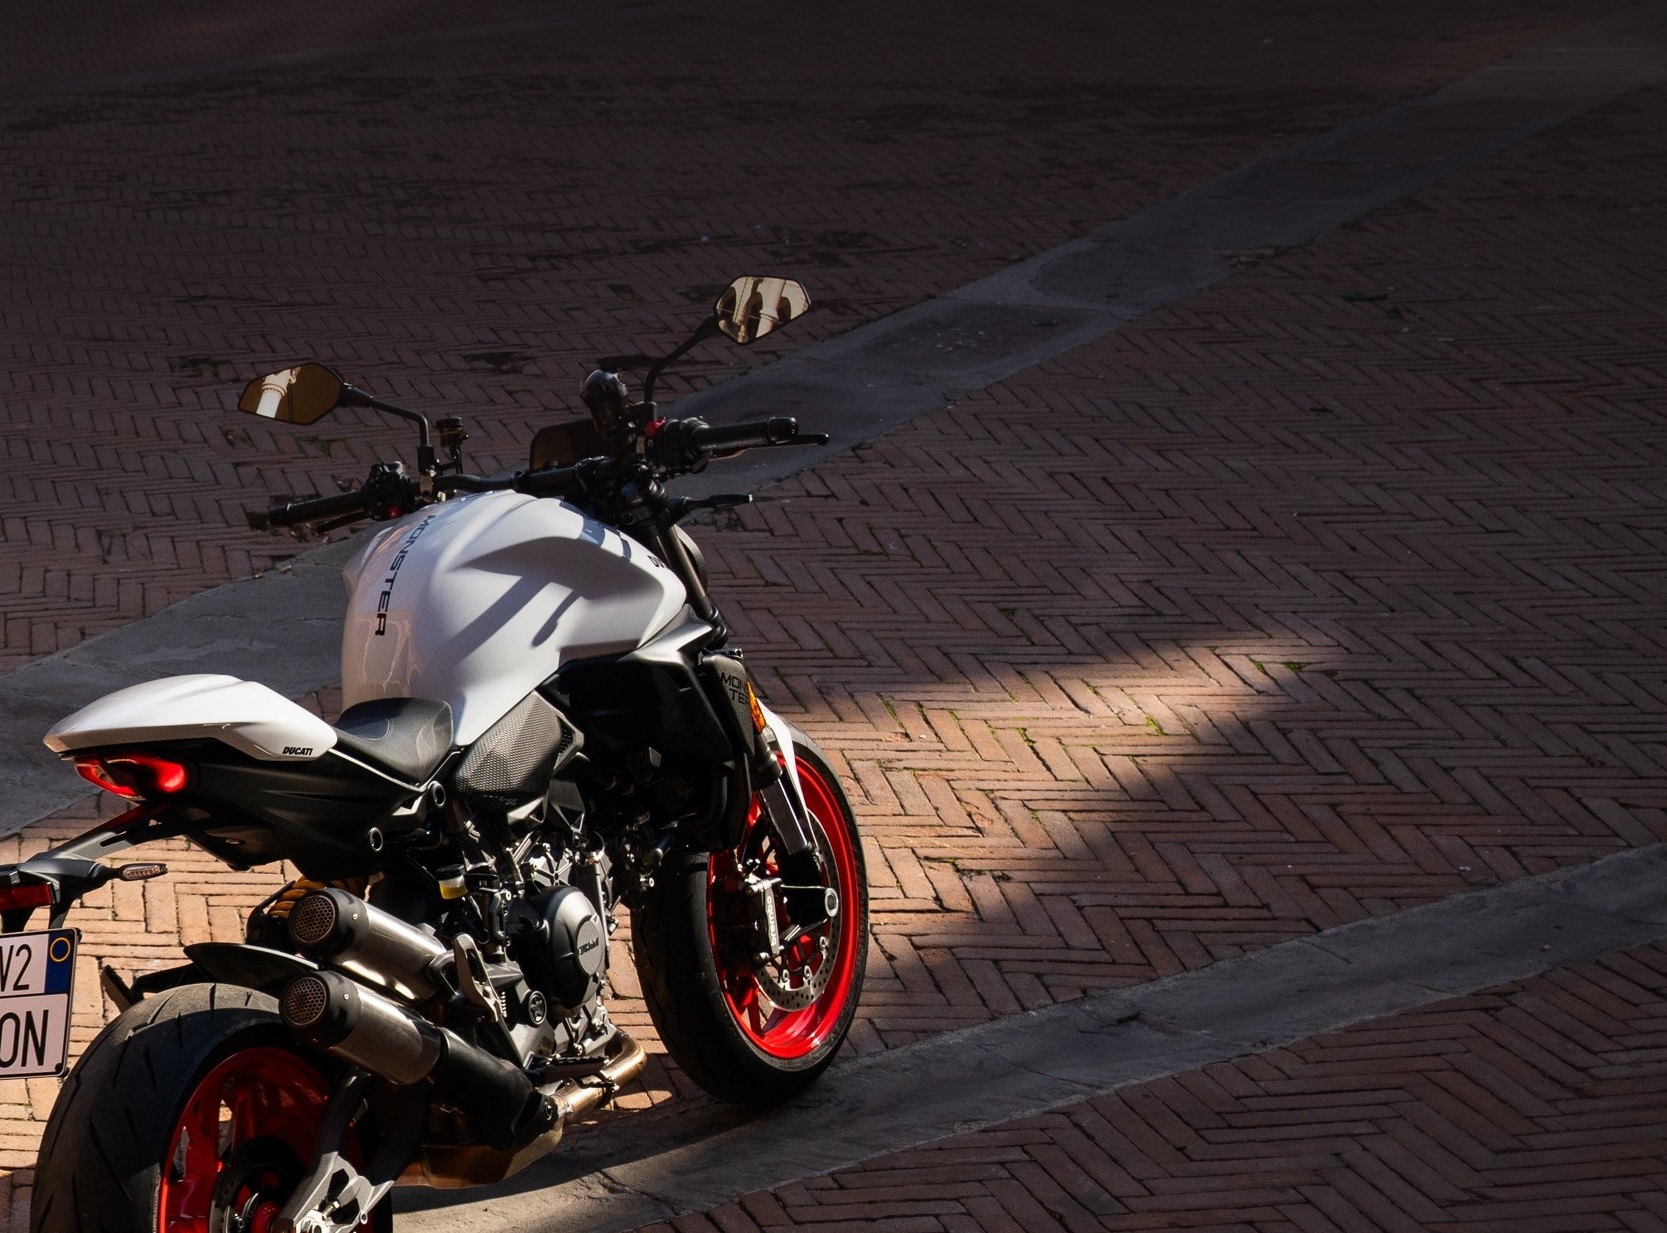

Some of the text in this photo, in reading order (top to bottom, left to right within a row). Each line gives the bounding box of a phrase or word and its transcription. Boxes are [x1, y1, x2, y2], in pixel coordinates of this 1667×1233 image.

[375, 515, 436, 636] MONSTER
[721, 672, 748, 692] MON
[282, 746, 314, 756] DUCATI
